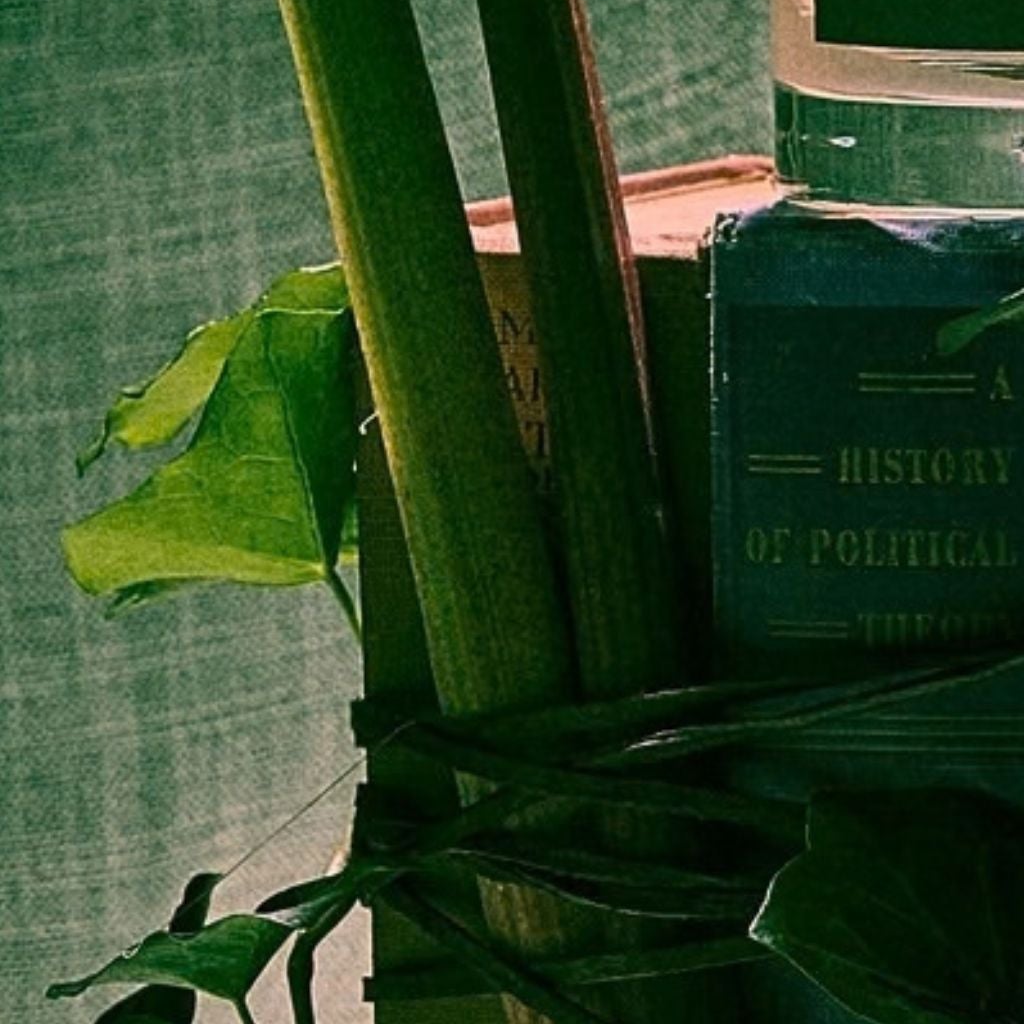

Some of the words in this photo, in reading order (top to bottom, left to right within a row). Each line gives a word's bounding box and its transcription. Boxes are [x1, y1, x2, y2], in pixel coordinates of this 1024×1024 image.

[989, 364, 1015, 401] A
[837, 446, 1016, 485] HISTORY
[745, 528, 791, 565] OF
[809, 528, 1017, 567] POLITICAL
